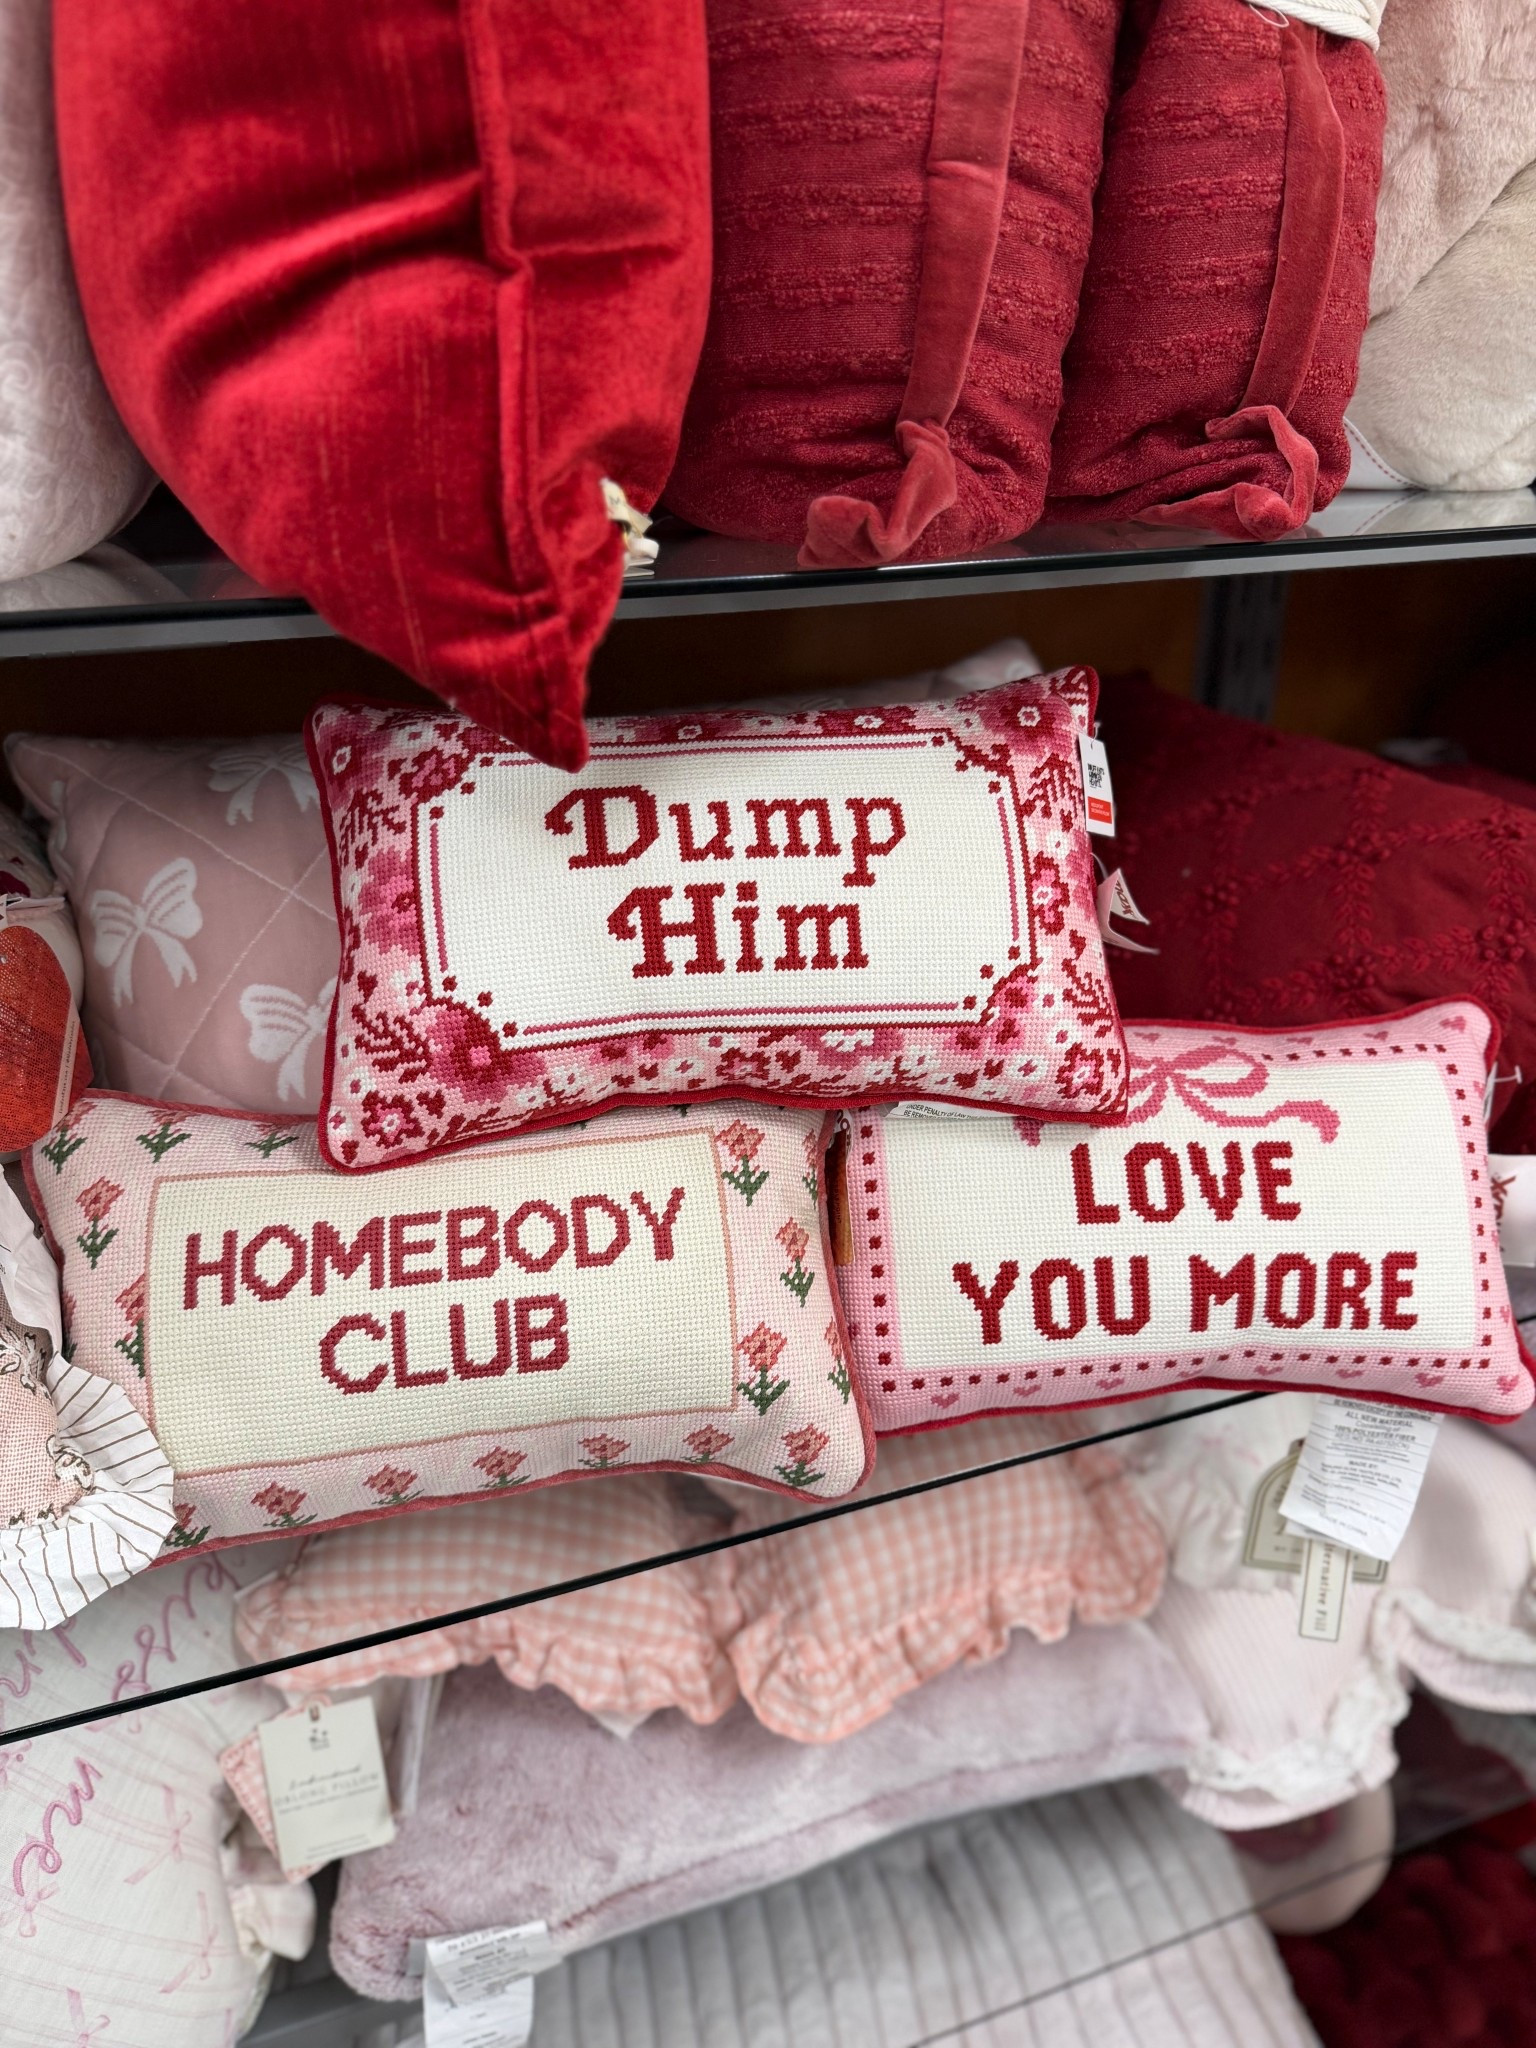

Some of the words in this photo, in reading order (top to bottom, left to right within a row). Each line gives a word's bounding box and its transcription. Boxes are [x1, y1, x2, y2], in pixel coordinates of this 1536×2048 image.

[545, 785, 906, 887] Dump
[606, 881, 870, 979] Him
[906, 1104, 924, 1112] UNDER
[924, 1106, 947, 1117] PENALTY
[1070, 1141, 1301, 1225] LOVE
[183, 1187, 685, 1310] HOMEBODY
[319, 1293, 569, 1395] CLUB
[952, 1253, 1150, 1345] YOU
[1188, 1251, 1418, 1333] MORE
[1352, 1428, 1393, 1439] POLYESTER
[1378, 1417, 1413, 1427] MATERIAL
[13, 1757, 103, 1897] me
